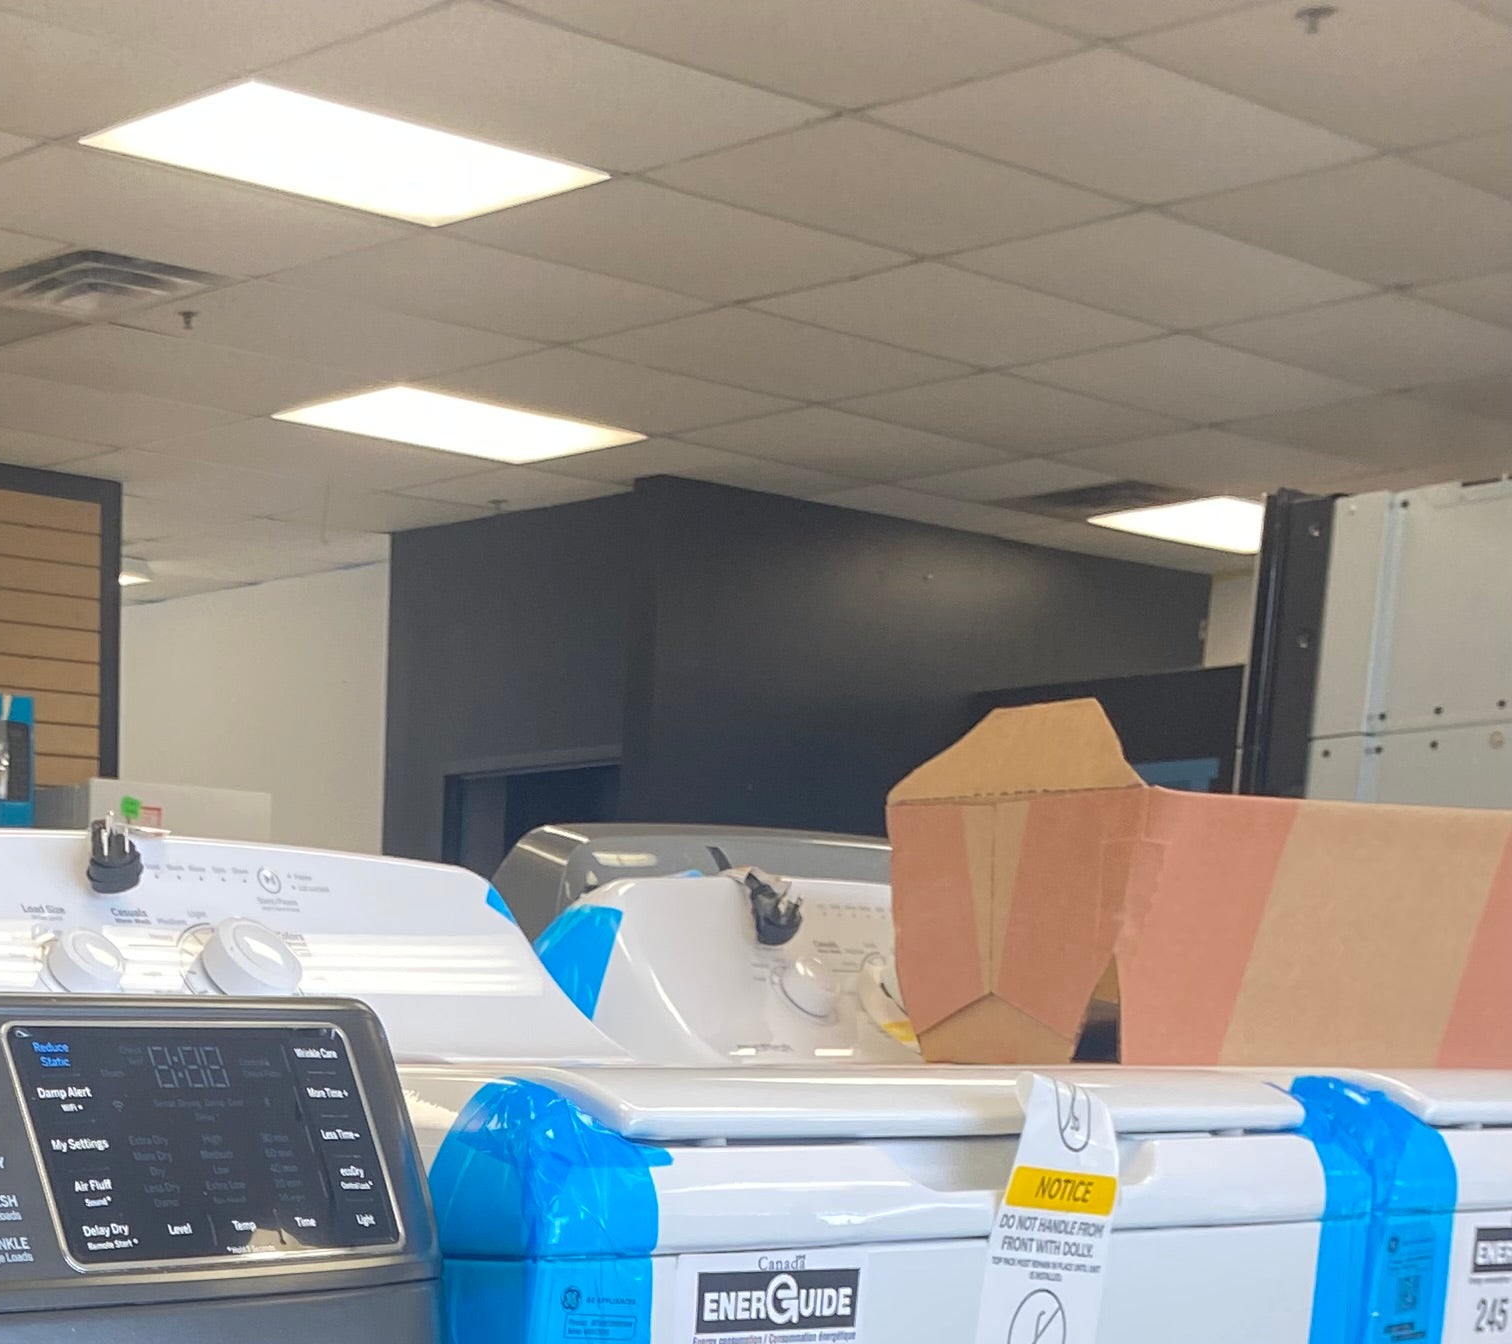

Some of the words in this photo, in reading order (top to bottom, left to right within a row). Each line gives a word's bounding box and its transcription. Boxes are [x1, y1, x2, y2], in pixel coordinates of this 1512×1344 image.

[110, 907, 148, 918] Casuals
[32, 1041, 69, 1053] Reduce
[39, 1055, 71, 1067] Static
[36, 1087, 67, 1100] Damp
[67, 1086, 93, 1098] Alert
[51, 1139, 67, 1153] My
[68, 1138, 109, 1151] Settings
[74, 1180, 89, 1192] Air
[89, 1179, 113, 1191] Fluff
[1035, 1176, 1094, 1203] NOTICE
[232, 1220, 257, 1232] Temp
[294, 1216, 317, 1228] Time
[355, 1214, 376, 1227] Light
[999, 1213, 1015, 1229] DO
[1016, 1216, 1038, 1231] NOT
[1037, 1217, 1078, 1236] HANDLE
[1077, 1221, 1104, 1238] FROM
[82, 1224, 110, 1238] Delay
[110, 1223, 129, 1236] Dry
[167, 1223, 193, 1235] Level
[114, 1239, 133, 1249] Start
[1001, 1235, 1034, 1253] FRONT
[1035, 1238, 1061, 1255] WITH
[5, 1251, 34, 1263] Loads
[758, 1254, 806, 1270] Canada
[703, 1273, 852, 1324] ENERGUIDE
[1474, 1297, 1509, 1332] 245
